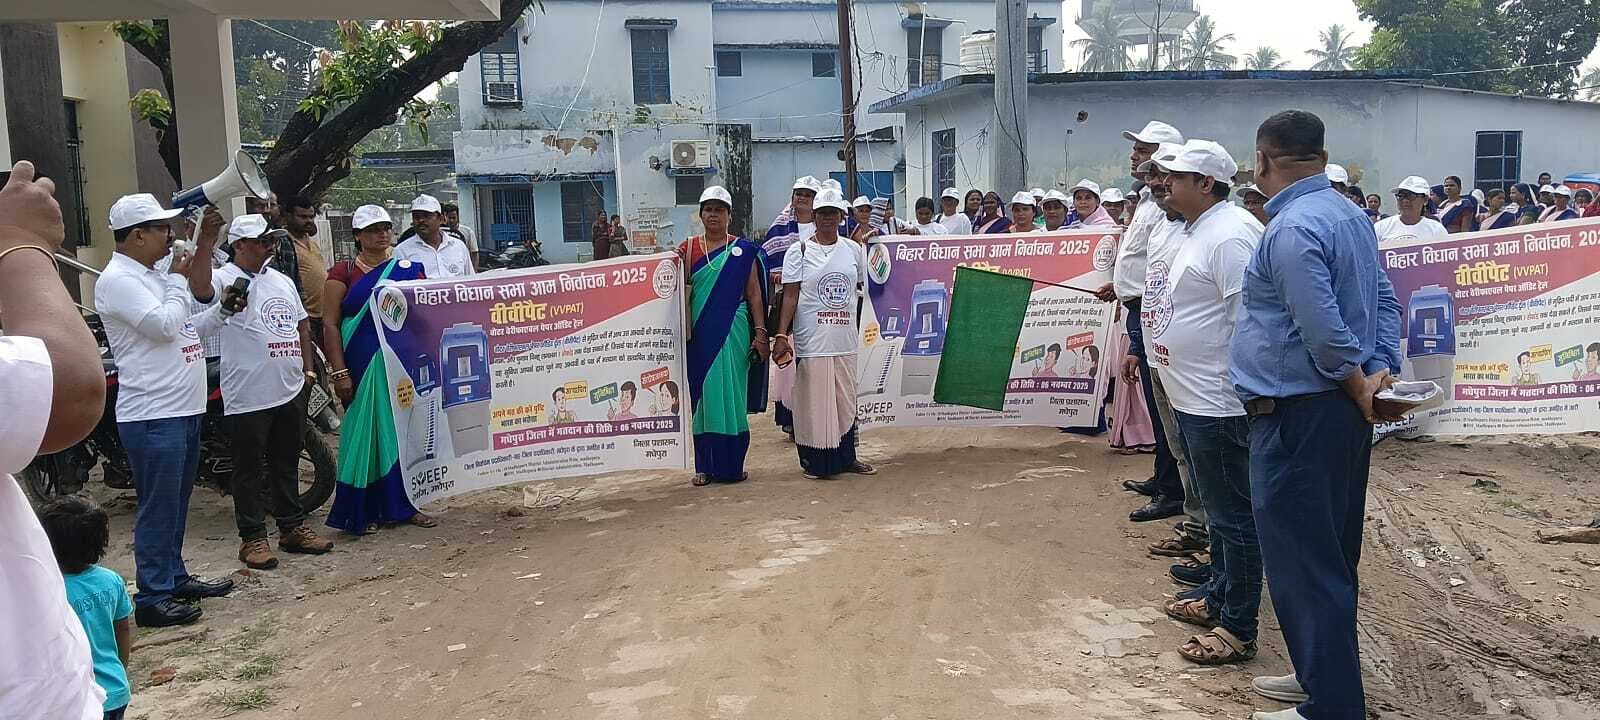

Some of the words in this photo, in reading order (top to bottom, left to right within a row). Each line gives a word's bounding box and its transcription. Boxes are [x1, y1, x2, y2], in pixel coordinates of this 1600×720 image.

[896, 243, 926, 261] बिहार
[928, 242, 961, 260] विधान
[963, 245, 986, 259] सभा
[989, 243, 1012, 258] आम
[1058, 240, 1090, 255] 2025
[1385, 250, 1419, 270] बिहार
[1422, 246, 1459, 265] विधान
[1462, 243, 1489, 260] सभा
[1494, 240, 1520, 256] आम
[1454, 260, 1510, 286] वीवीपैट
[1513, 262, 1548, 279] (VVPAT)
[414, 287, 451, 305] बिहार
[455, 284, 495, 302] विधान
[497, 281, 525, 299] सभा
[531, 279, 557, 296] आम
[613, 267, 647, 286] 2025
[1455, 290, 1469, 298] वोटर
[1504, 284, 1517, 294] पेपर
[1518, 282, 1536, 292] ऑडिट
[1537, 280, 1548, 291] ट्रेल
[489, 300, 547, 324] वीवीपैट
[550, 302, 584, 318] (VVPAT)
[840, 310, 850, 318] तिथि
[490, 328, 504, 337] वोटर
[540, 322, 553, 332] पेपर
[554, 319, 572, 331] ऑडिट
[573, 319, 583, 331] ट्रेल
[268, 341, 293, 349] मतदान
[1010, 380, 1019, 389] की
[1020, 379, 1035, 389] तिथि
[1073, 382, 1088, 390] 2025
[1462, 386, 1486, 398] मधेपुरा
[1488, 386, 1508, 397] जिला
[1510, 386, 1518, 397] में
[1520, 387, 1545, 397] मतदान
[1547, 384, 1557, 395] की
[1560, 383, 1577, 394] तिथि
[1585, 384, 1595, 393] 06
[1050, 397, 1064, 406] जिला
[507, 408, 515, 416] मत
[517, 406, 523, 414] की
[858, 402, 893, 416] SWEEP
[1058, 407, 1078, 417] मधेपुरा
[515, 416, 521, 424] का
[500, 432, 525, 445] मधेपुरा
[526, 429, 546, 441] जिला
[557, 426, 581, 436] मतदान
[584, 423, 594, 434] की
[596, 423, 612, 434] तिथि
[620, 424, 629, 432] 06
[631, 422, 654, 430] नवम्बर
[656, 420, 674, 429] 2025
[633, 439, 650, 448] जिला
[651, 439, 679, 448] प्रशासन,
[645, 450, 667, 460] मधेपुरा
